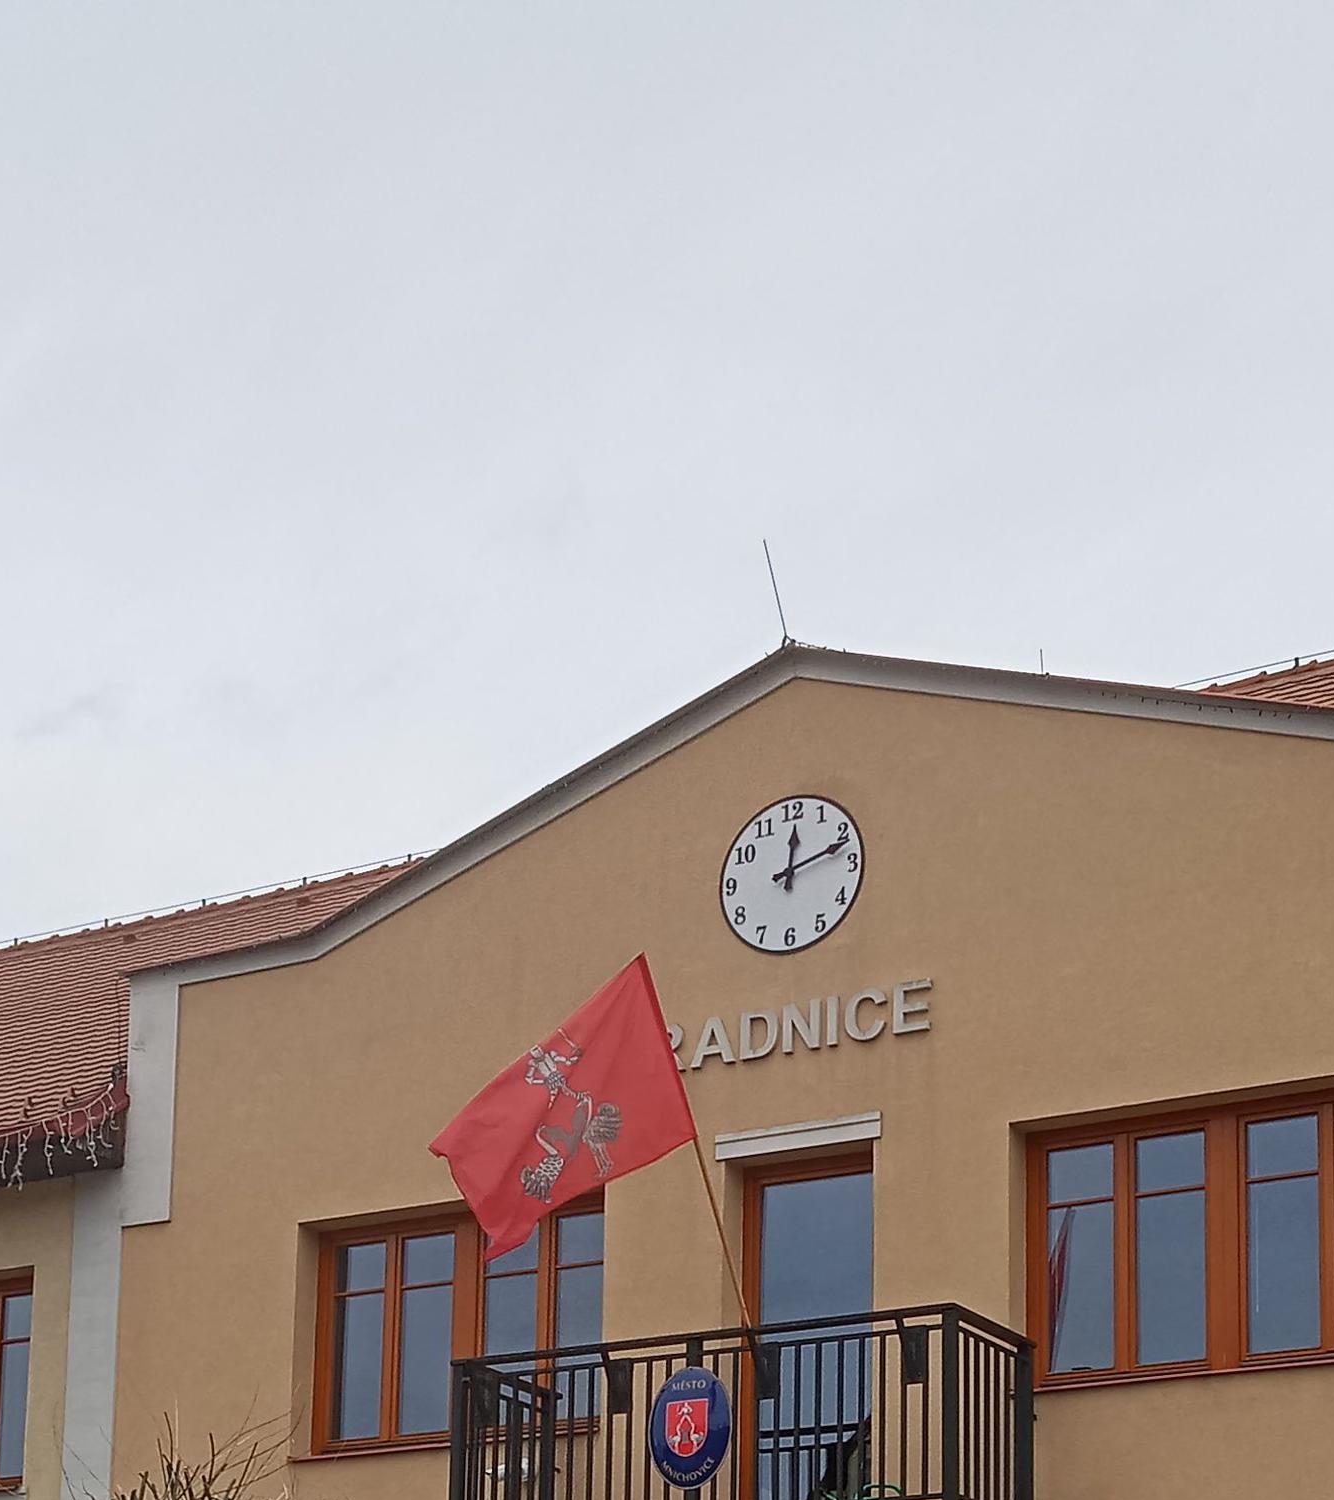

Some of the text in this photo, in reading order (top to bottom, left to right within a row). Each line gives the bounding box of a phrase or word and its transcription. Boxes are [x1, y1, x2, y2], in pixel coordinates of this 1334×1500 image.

[781, 801, 805, 824] 12
[816, 805, 828, 824] 1
[755, 818, 775, 840] 11
[837, 822, 850, 842] 2
[735, 844, 757, 866] 10
[847, 853, 859, 873] 3
[726, 877, 738, 897] 9
[835, 886, 848, 906] 4
[735, 906, 747, 926] 8
[814, 913, 827, 933] 5
[755, 925, 768, 945] 7
[784, 927, 797, 947] 6
[660, 1456, 716, 1483] MNICHOVICE
